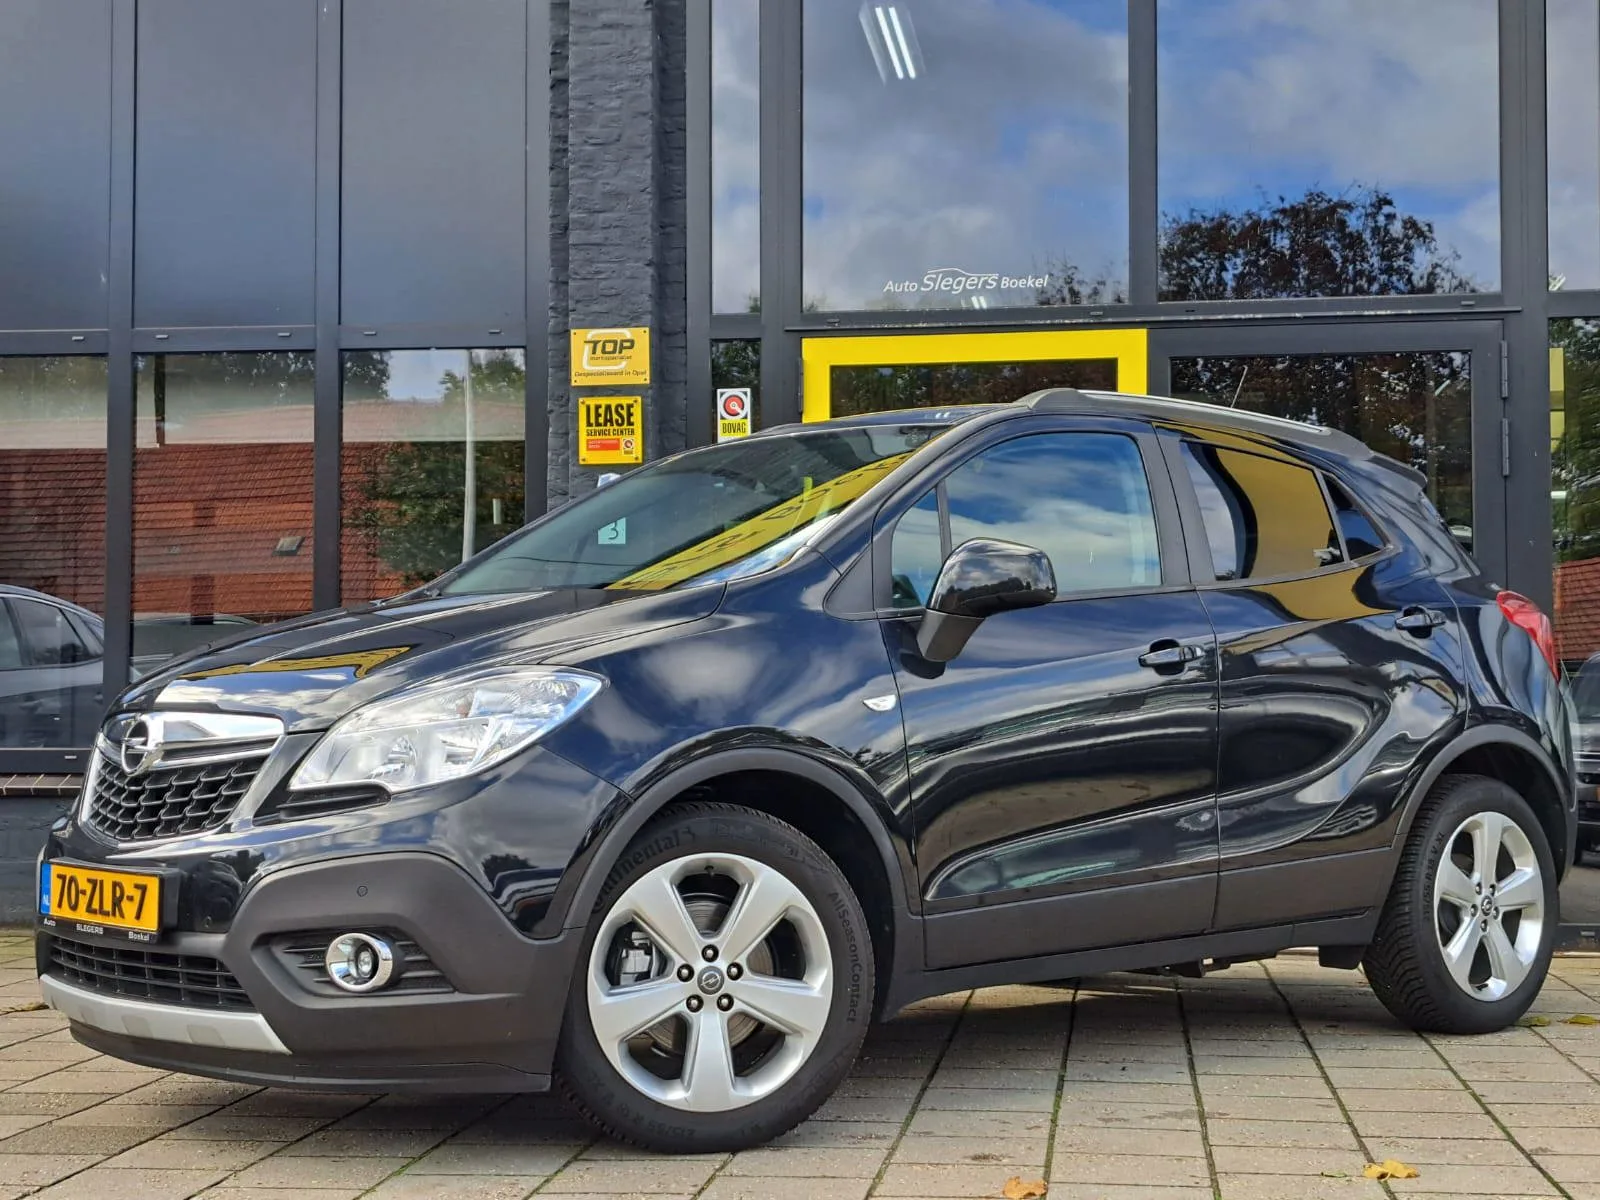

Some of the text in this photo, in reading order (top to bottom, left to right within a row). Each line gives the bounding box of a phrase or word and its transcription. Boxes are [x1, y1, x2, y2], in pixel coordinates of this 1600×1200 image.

[883, 273, 1050, 294] Auto Slegers Boekel
[584, 338, 635, 355] TOP
[586, 404, 634, 427] LEASE
[586, 428, 635, 437] SERVICE CENTER
[722, 421, 746, 434] BOVAG
[42, 893, 50, 906] NL
[56, 873, 148, 921] 70-ZLR-7
[43, 917, 150, 941] Auto SLEGERS Boekel
[827, 891, 862, 1023] AllSeasonContact
